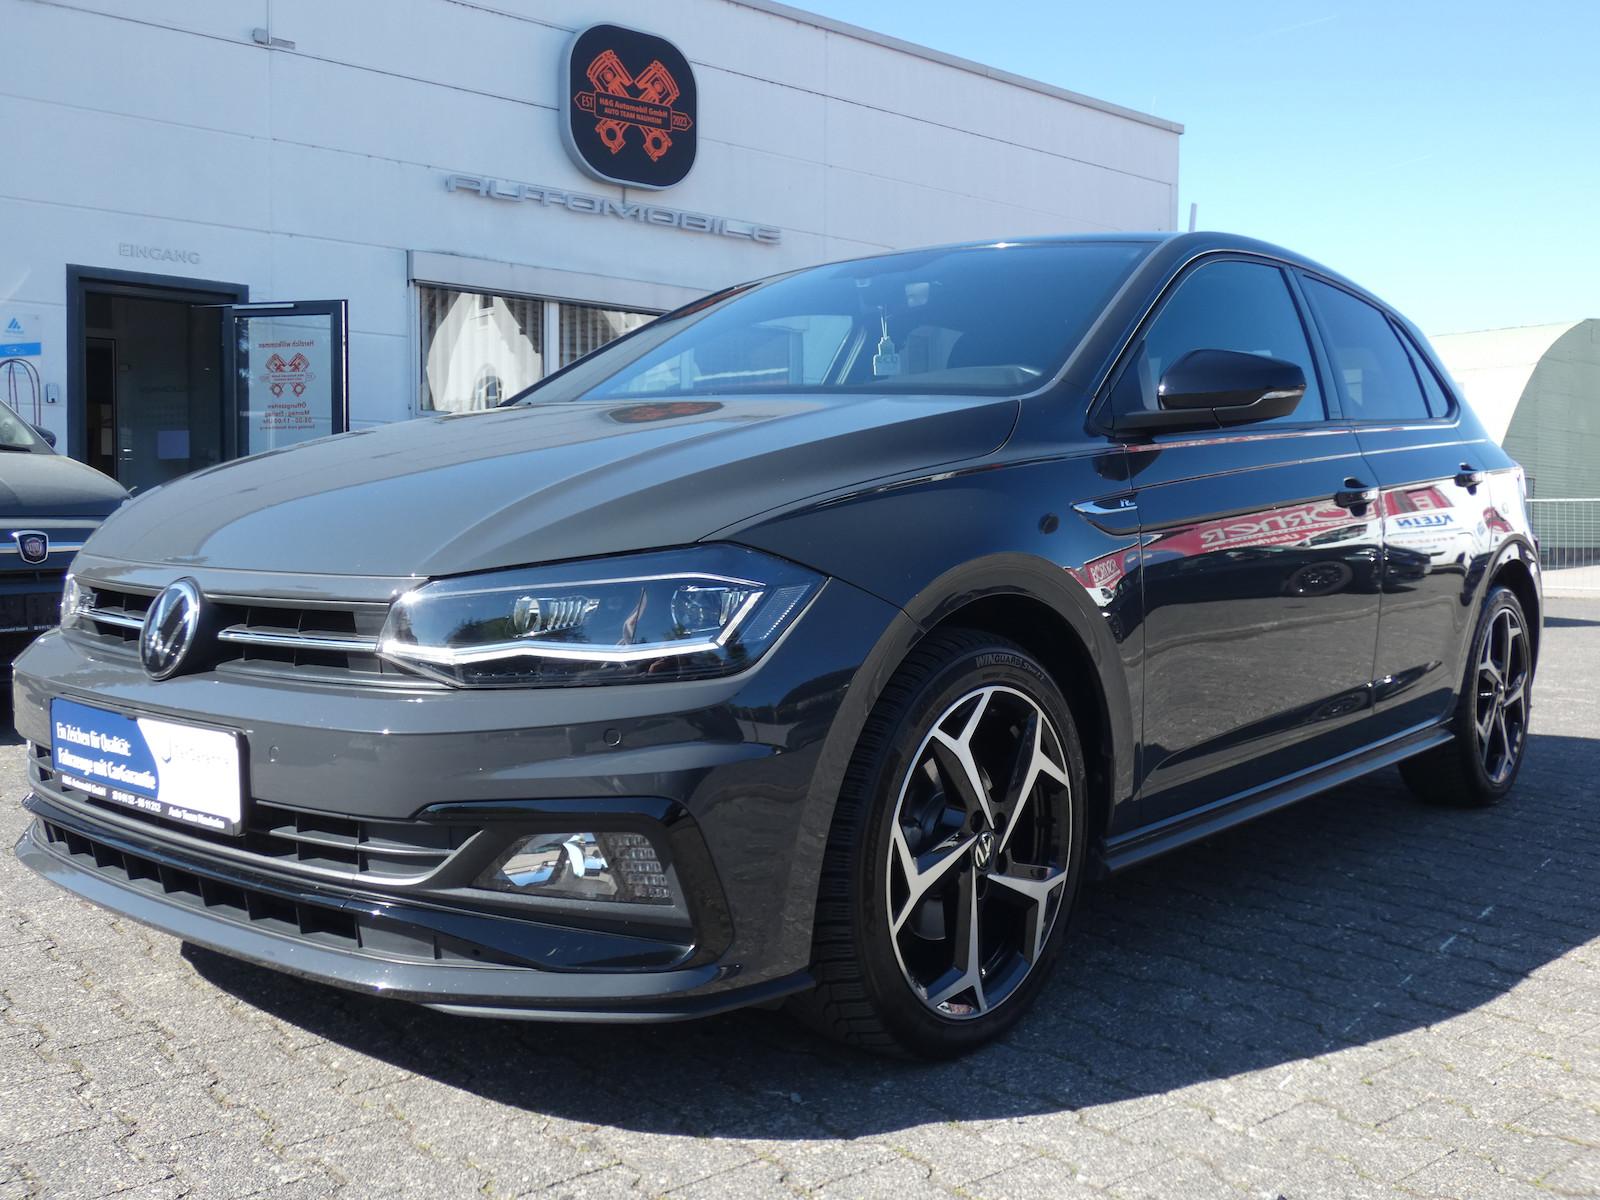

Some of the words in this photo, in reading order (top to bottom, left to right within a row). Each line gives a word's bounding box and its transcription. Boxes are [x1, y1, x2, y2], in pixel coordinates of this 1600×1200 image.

[581, 95, 593, 108] EST
[614, 100, 648, 114] Automobil
[648, 107, 668, 118] GmbH
[445, 174, 783, 245] AUTOMOBILE
[118, 242, 201, 264] EINGANG
